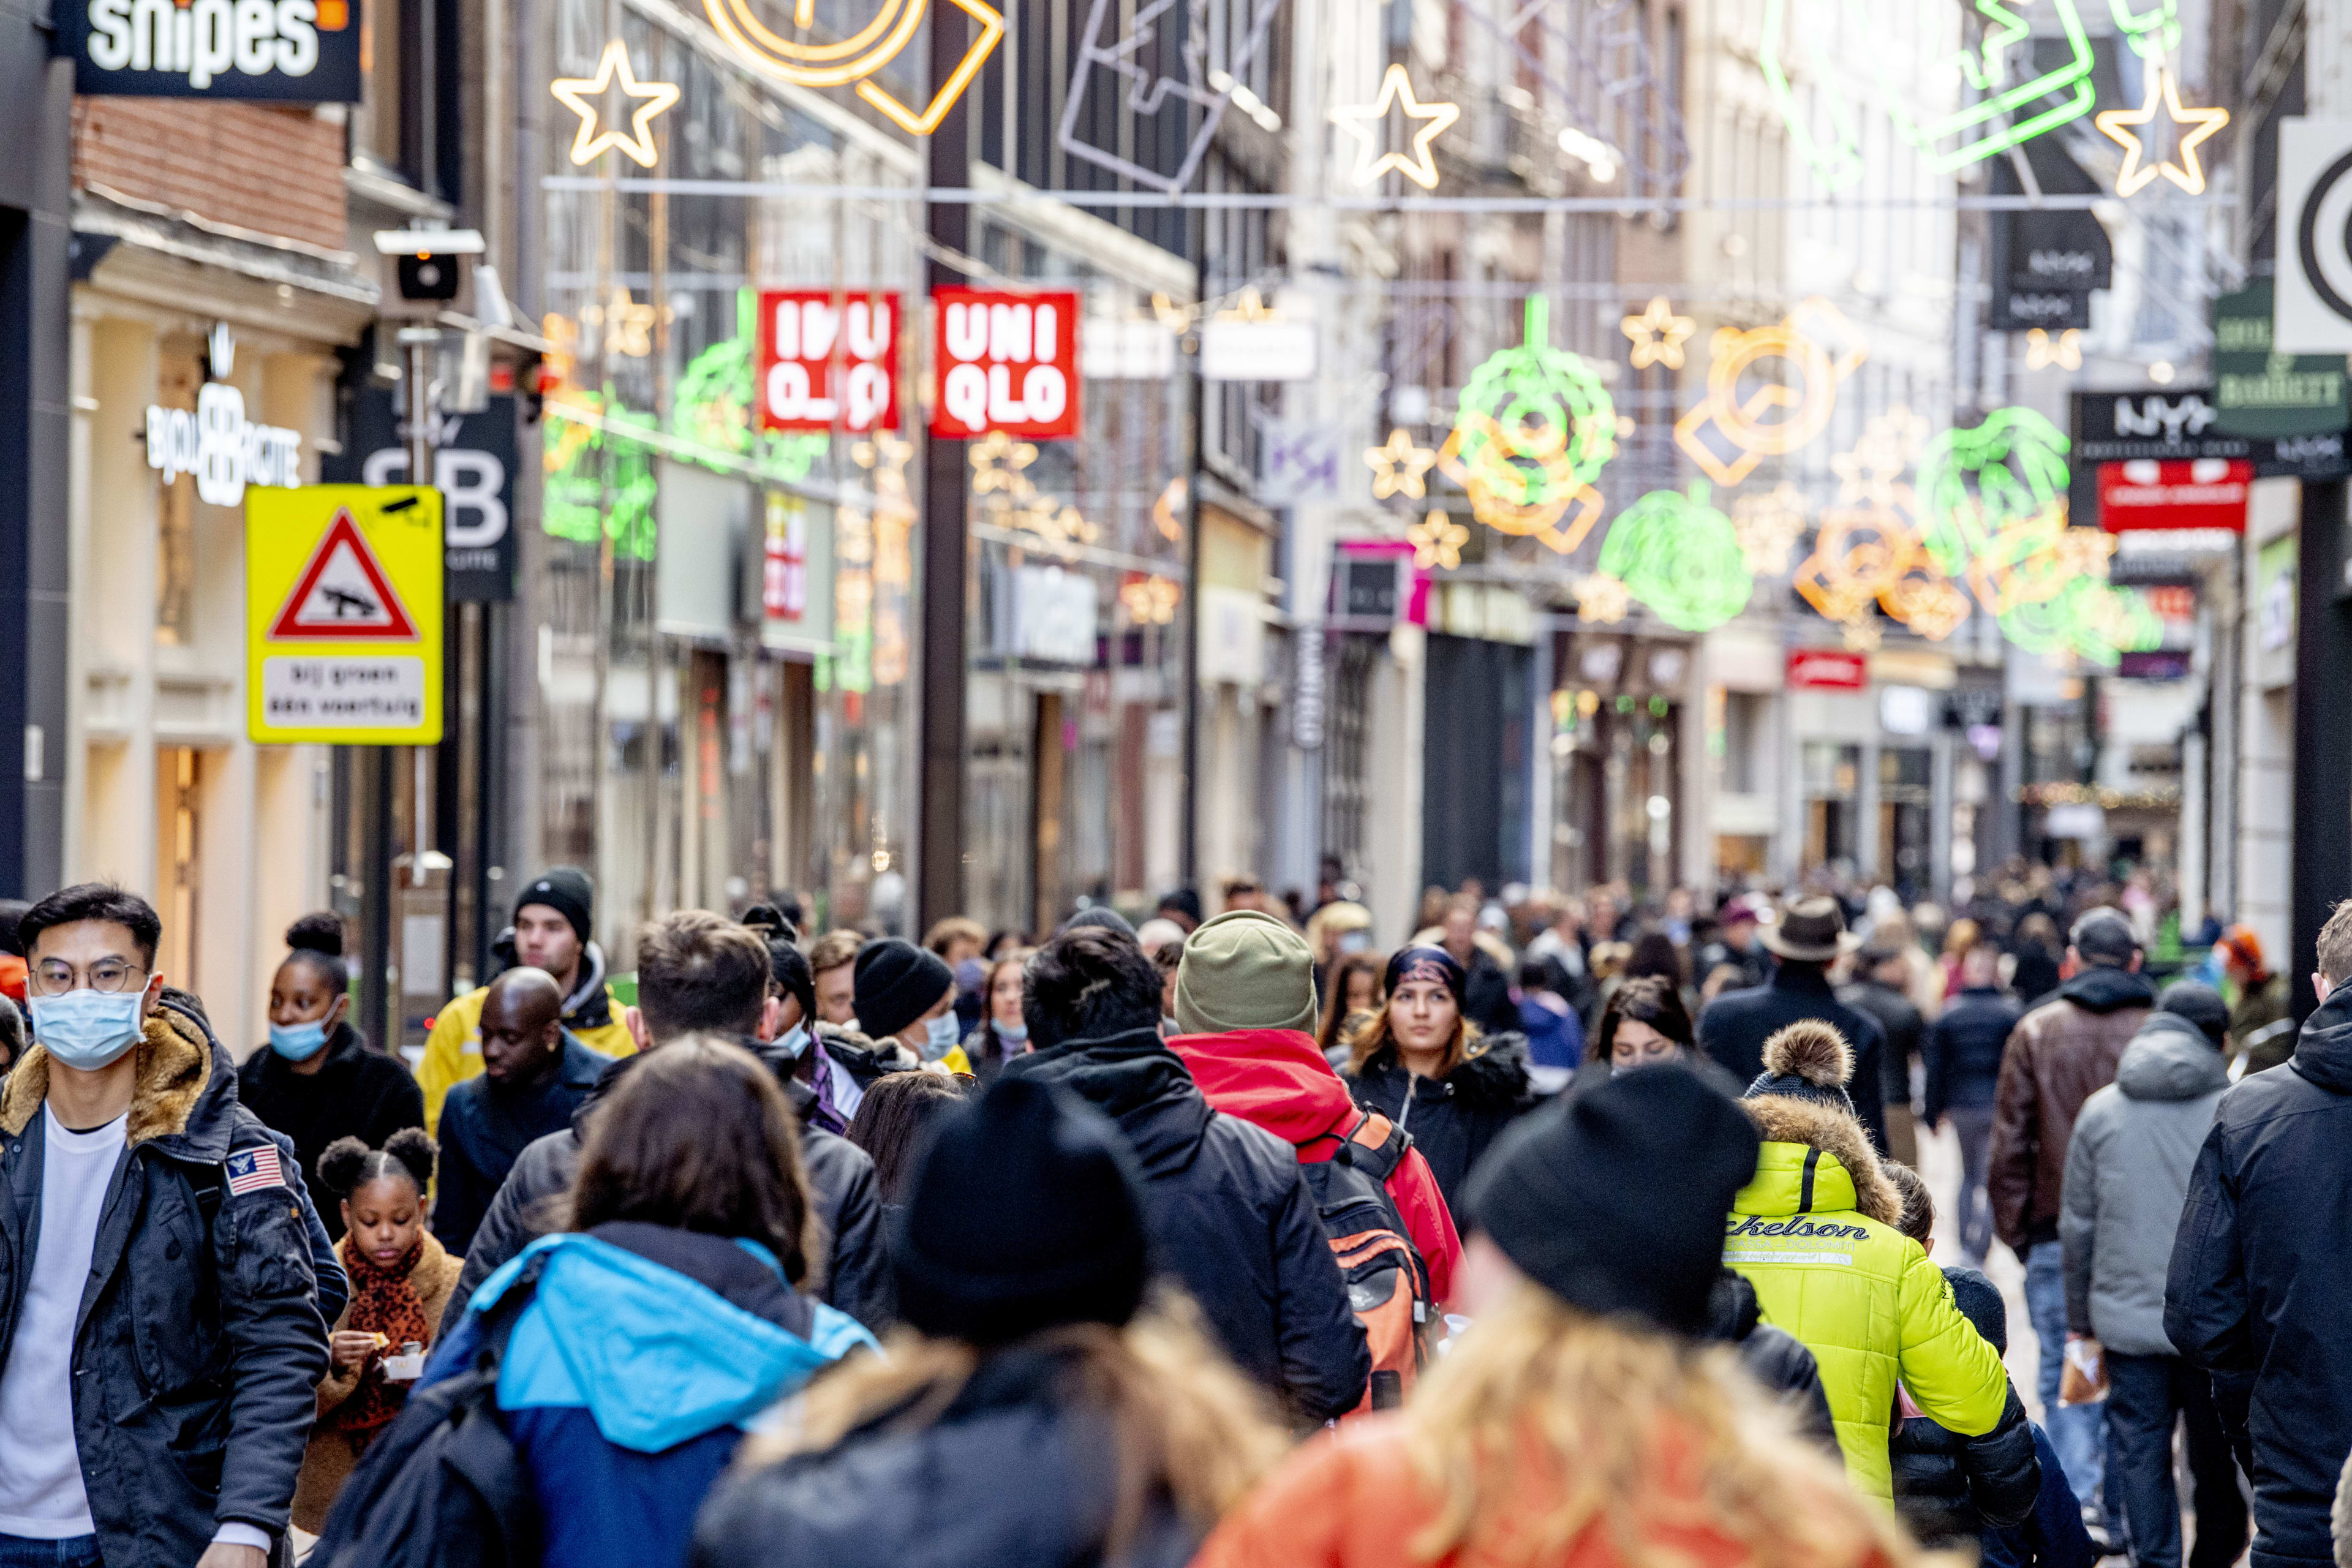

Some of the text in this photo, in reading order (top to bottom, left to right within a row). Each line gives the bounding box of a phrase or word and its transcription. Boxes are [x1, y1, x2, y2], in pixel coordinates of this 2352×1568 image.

[88, 0, 318, 89] snipes
[946, 303, 1057, 363] UNI
[945, 364, 1066, 431] QLO
[330, 665, 397, 686] groen
[1731, 1238, 1773, 1250] FASSA
[1786, 1238, 1855, 1251] DOLOMITI
